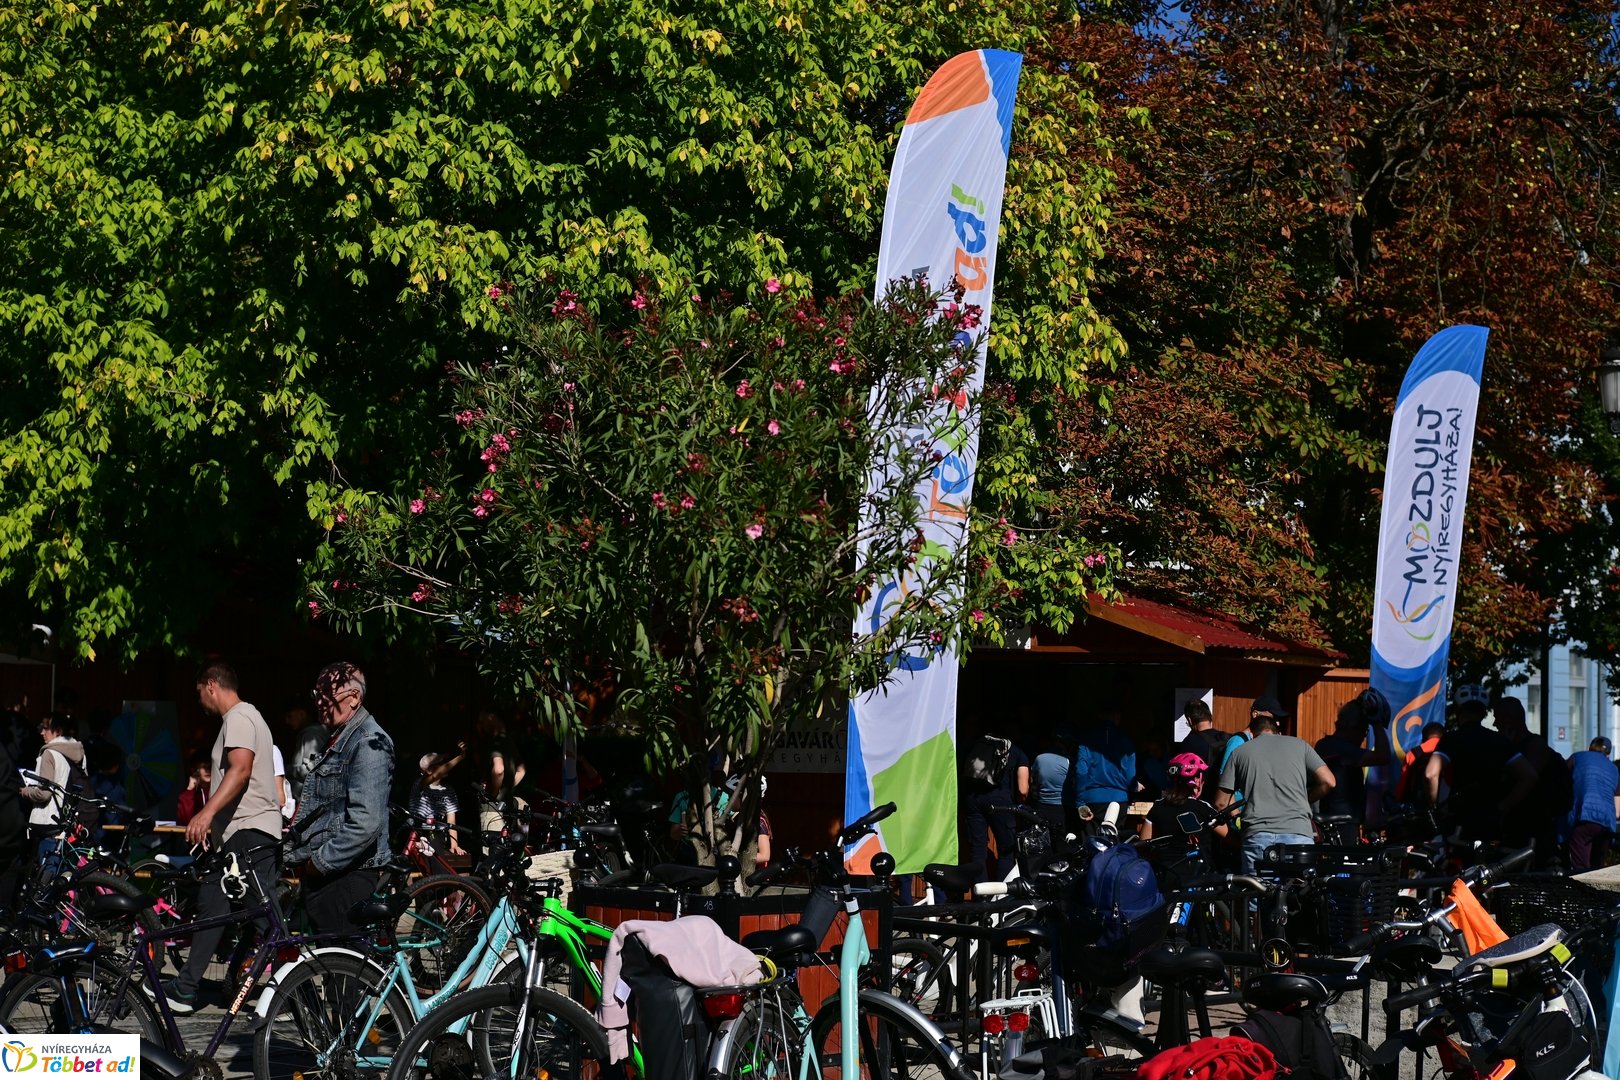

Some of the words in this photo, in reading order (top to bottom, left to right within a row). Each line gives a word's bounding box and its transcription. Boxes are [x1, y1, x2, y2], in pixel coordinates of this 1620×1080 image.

[947, 183, 988, 291] ad!
[1402, 404, 1443, 584] MOZDULJ
[1433, 407, 1463, 586] NYÍREGYHÁZA!
[228, 974, 256, 1015] HERCULES
[1535, 1042, 1555, 1058] KLS
